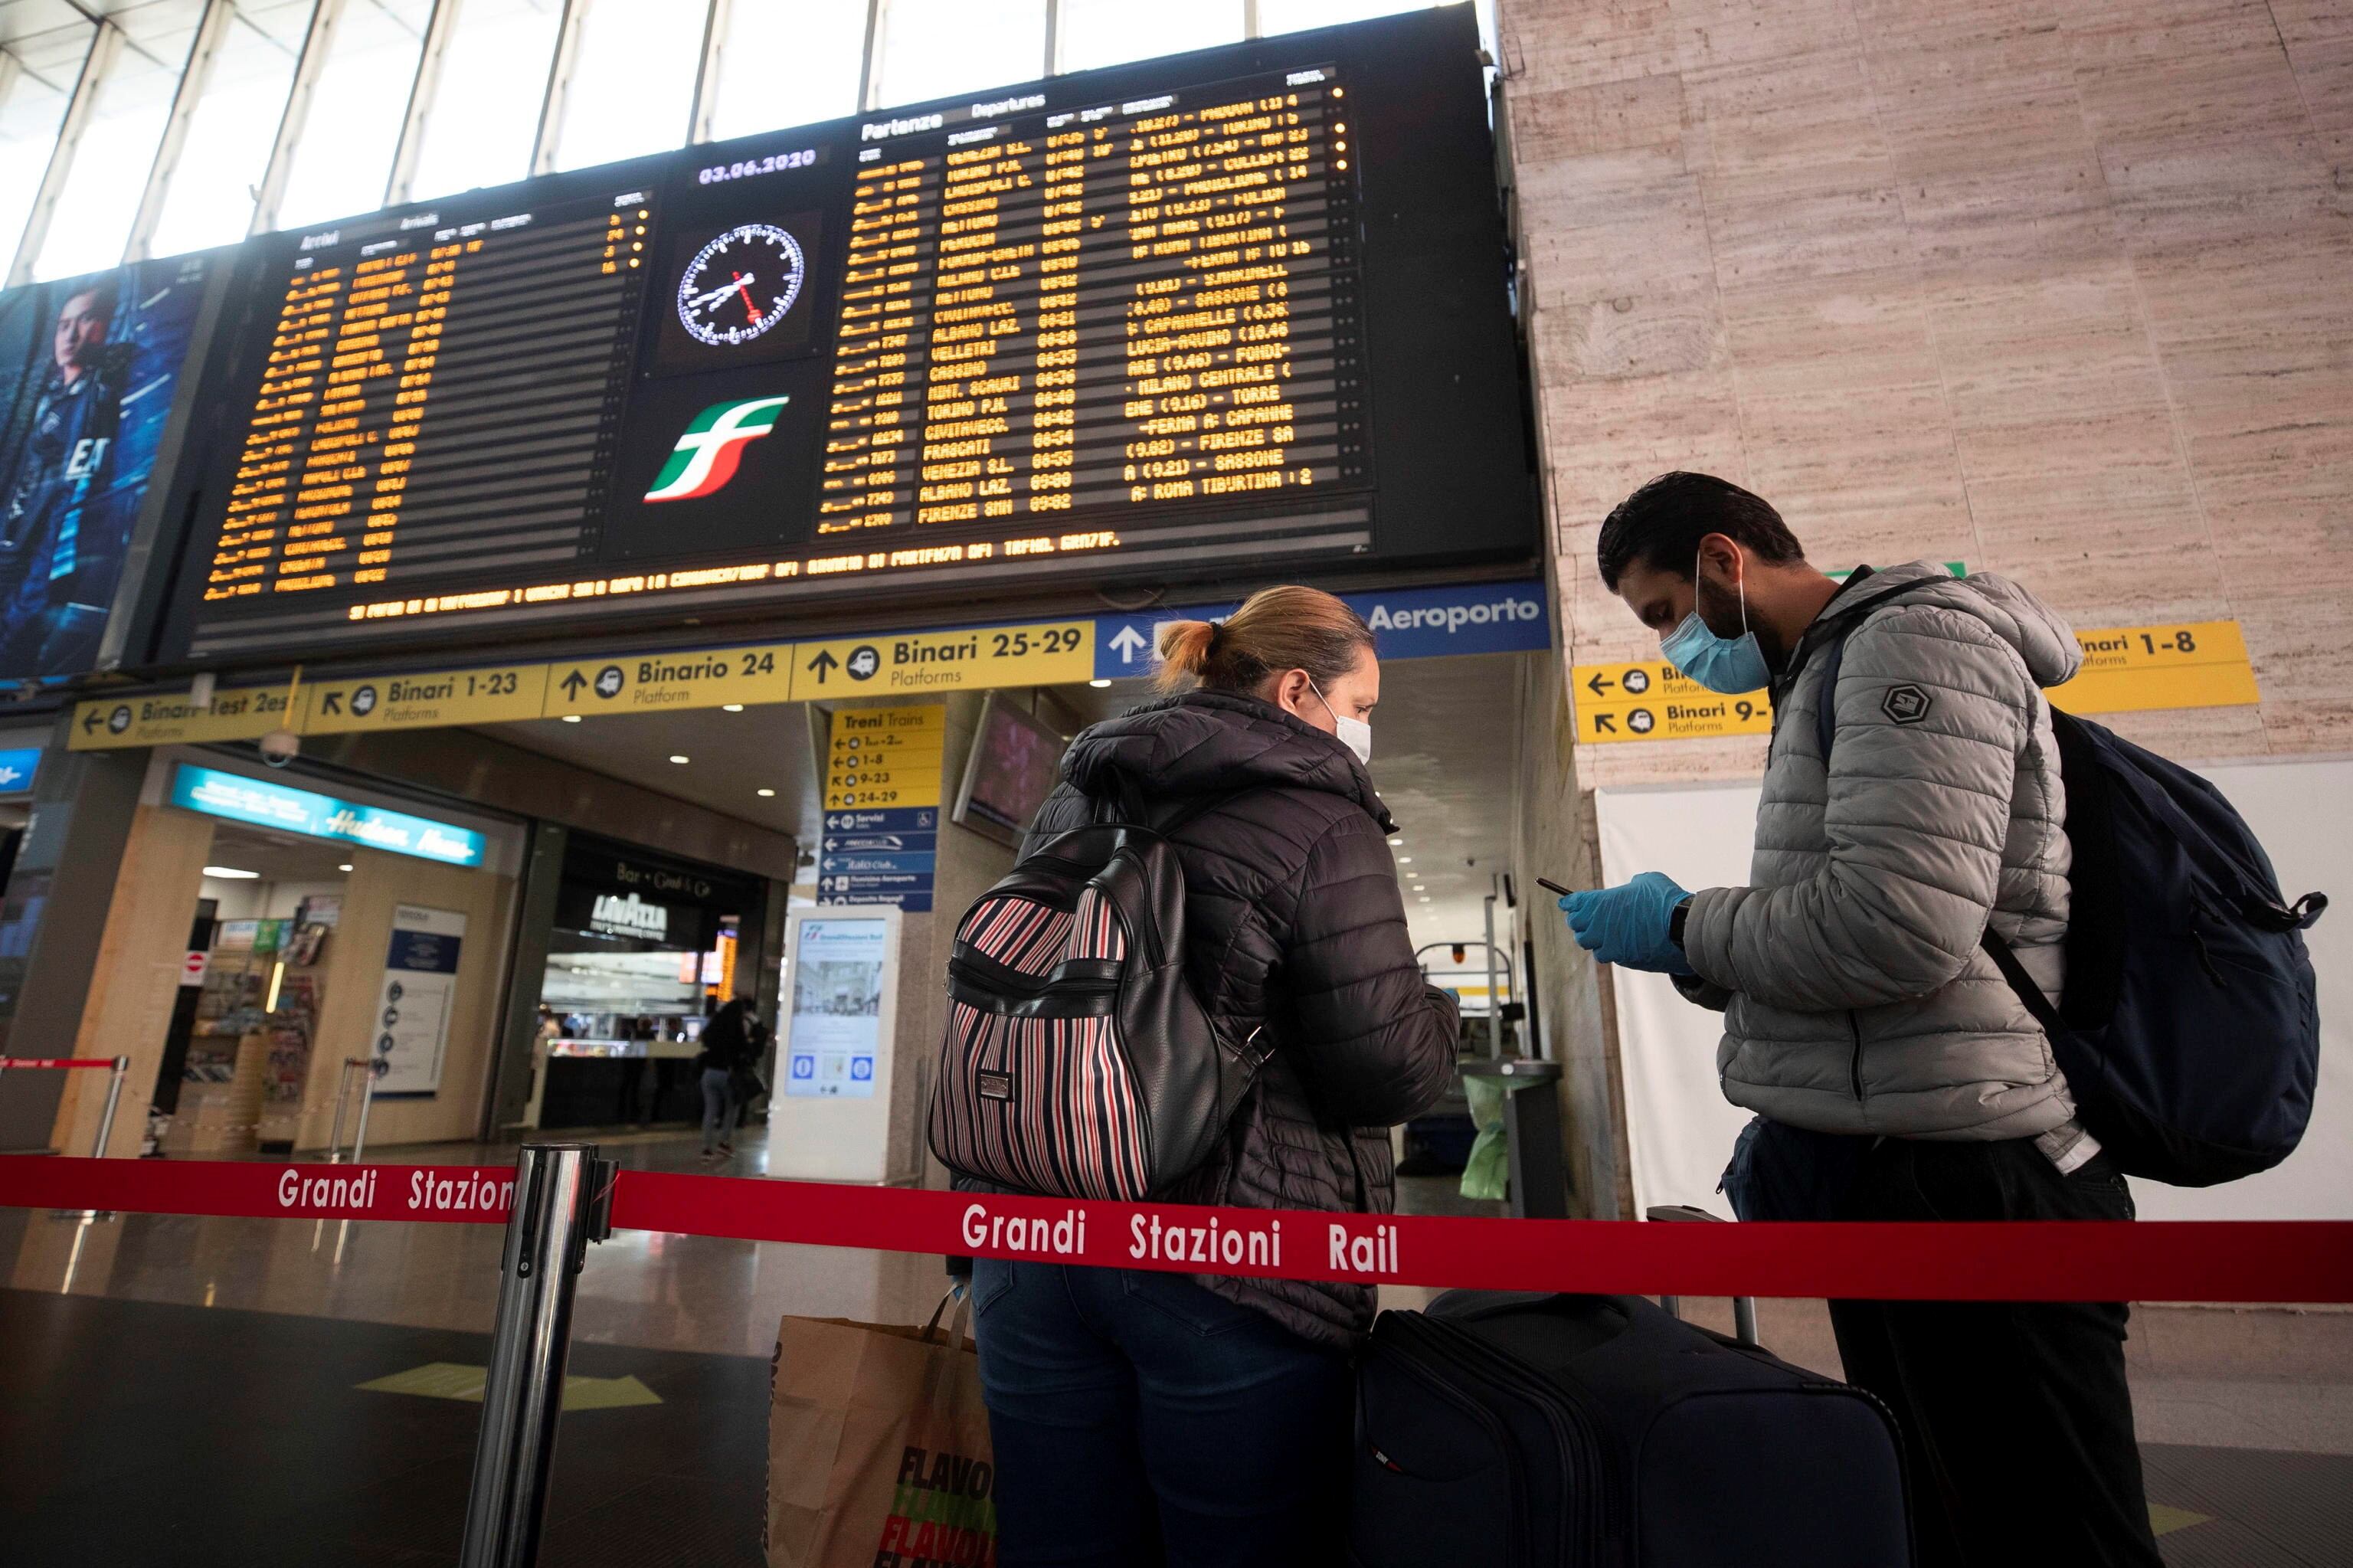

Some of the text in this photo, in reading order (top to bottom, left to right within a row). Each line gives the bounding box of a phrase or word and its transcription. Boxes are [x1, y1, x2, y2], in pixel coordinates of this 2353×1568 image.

[861, 113, 943, 142] Partenze
[971, 94, 1046, 119] Departures
[699, 149, 817, 185] 03.06.2020
[300, 230, 340, 251] Arrivi
[931, 340, 997, 361] VELLETRI
[928, 401, 975, 421] TORINO
[1137, 375, 1192, 395] MILANO
[1199, 364, 1275, 388] CENTRALE
[1232, 385, 1280, 404] TORRE
[922, 460, 980, 480] VENEZIA
[1199, 429, 1265, 450] FIRENZE
[923, 438, 990, 460] FRASCATI
[918, 503, 977, 523] FIRENZE
[1154, 480, 1193, 499] ROMA
[1201, 471, 1282, 494] TIBURTINA
[919, 482, 974, 502] ALBANO
[1368, 597, 1540, 633] Aeroporto
[893, 628, 1082, 664] Binari 25-29
[2140, 630, 2198, 656] 1-8
[637, 654, 775, 684] Binario 24
[890, 666, 961, 686] Platforms
[388, 675, 519, 702] Binari 1-23
[633, 687, 690, 705] Platform
[1663, 683, 1708, 695] Platfor
[254, 692, 295, 712] 2es
[1667, 700, 1772, 722] Binari 9-
[383, 705, 439, 722] Platforms
[845, 712, 924, 728] Treni Trains
[1667, 720, 1723, 734] Platforms
[863, 753, 883, 765] 1-8
[859, 772, 890, 784] 9-23
[859, 791, 898, 803] 24-29
[591, 892, 668, 931] LAVAZZA
[278, 1169, 516, 1211] Grandi Stazion
[962, 1203, 1399, 1274] Grandi Stazioni Rail
[897, 1445, 997, 1503] FLAVO
